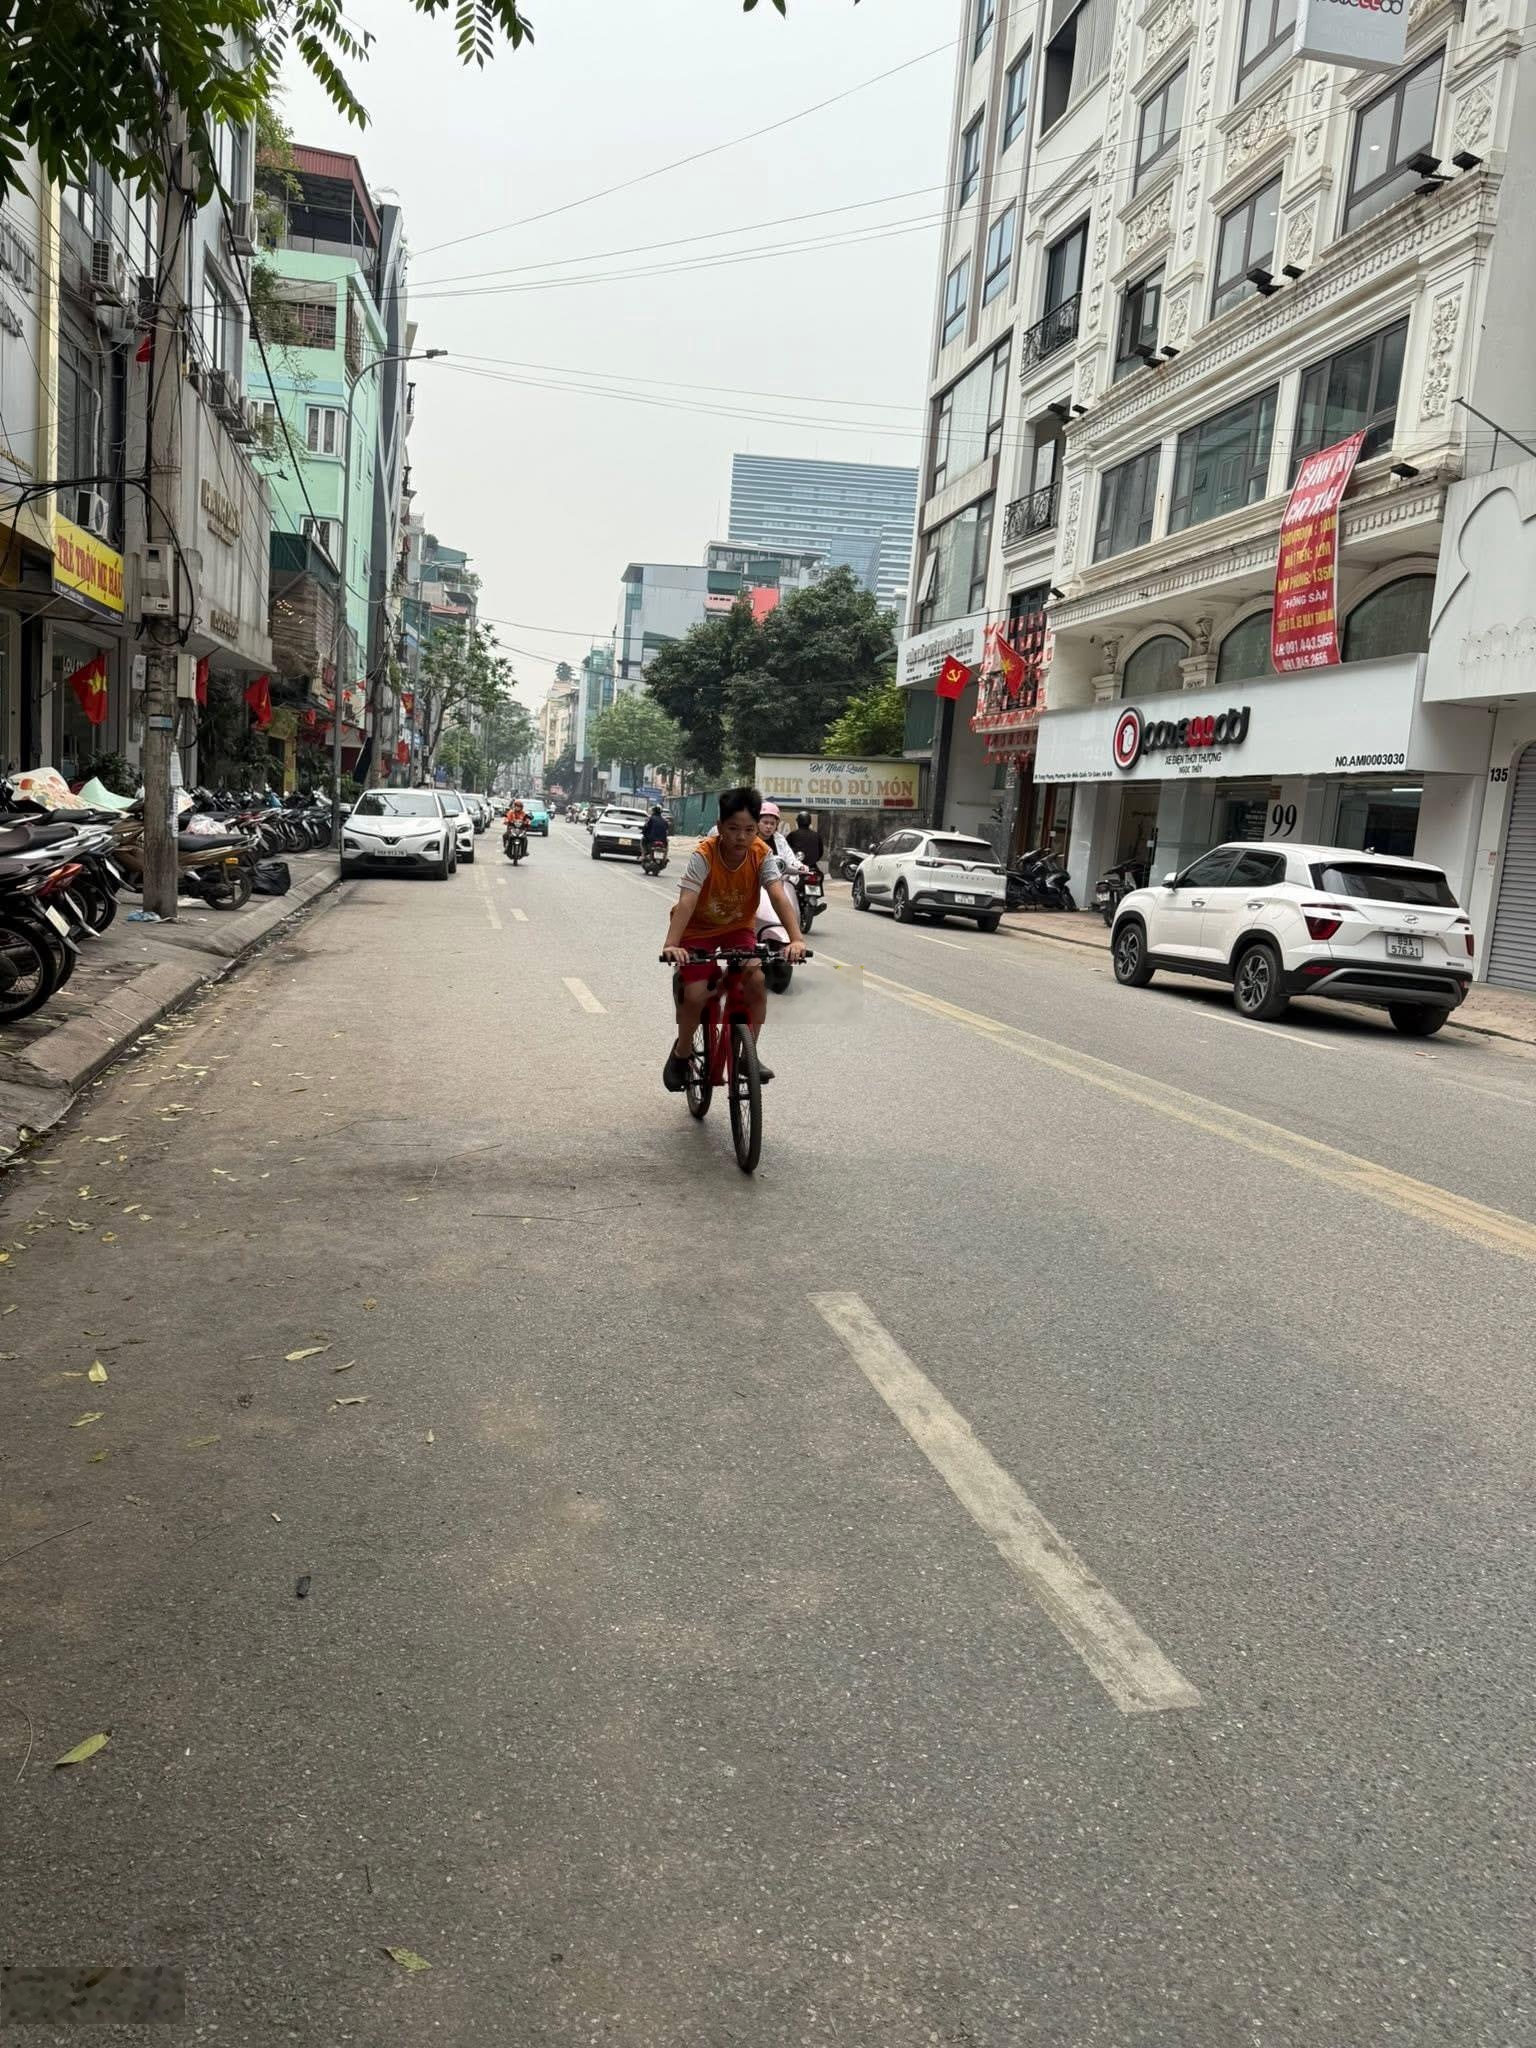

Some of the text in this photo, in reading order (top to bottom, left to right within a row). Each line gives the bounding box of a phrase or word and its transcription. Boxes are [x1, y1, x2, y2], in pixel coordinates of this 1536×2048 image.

[1335, 753, 1405, 767] NO.AMI0003030
[762, 773, 914, 797] THỊT CHÓ ĐỦ MÓN
[1489, 768, 1509, 783] 135
[1269, 804, 1298, 837] 99
